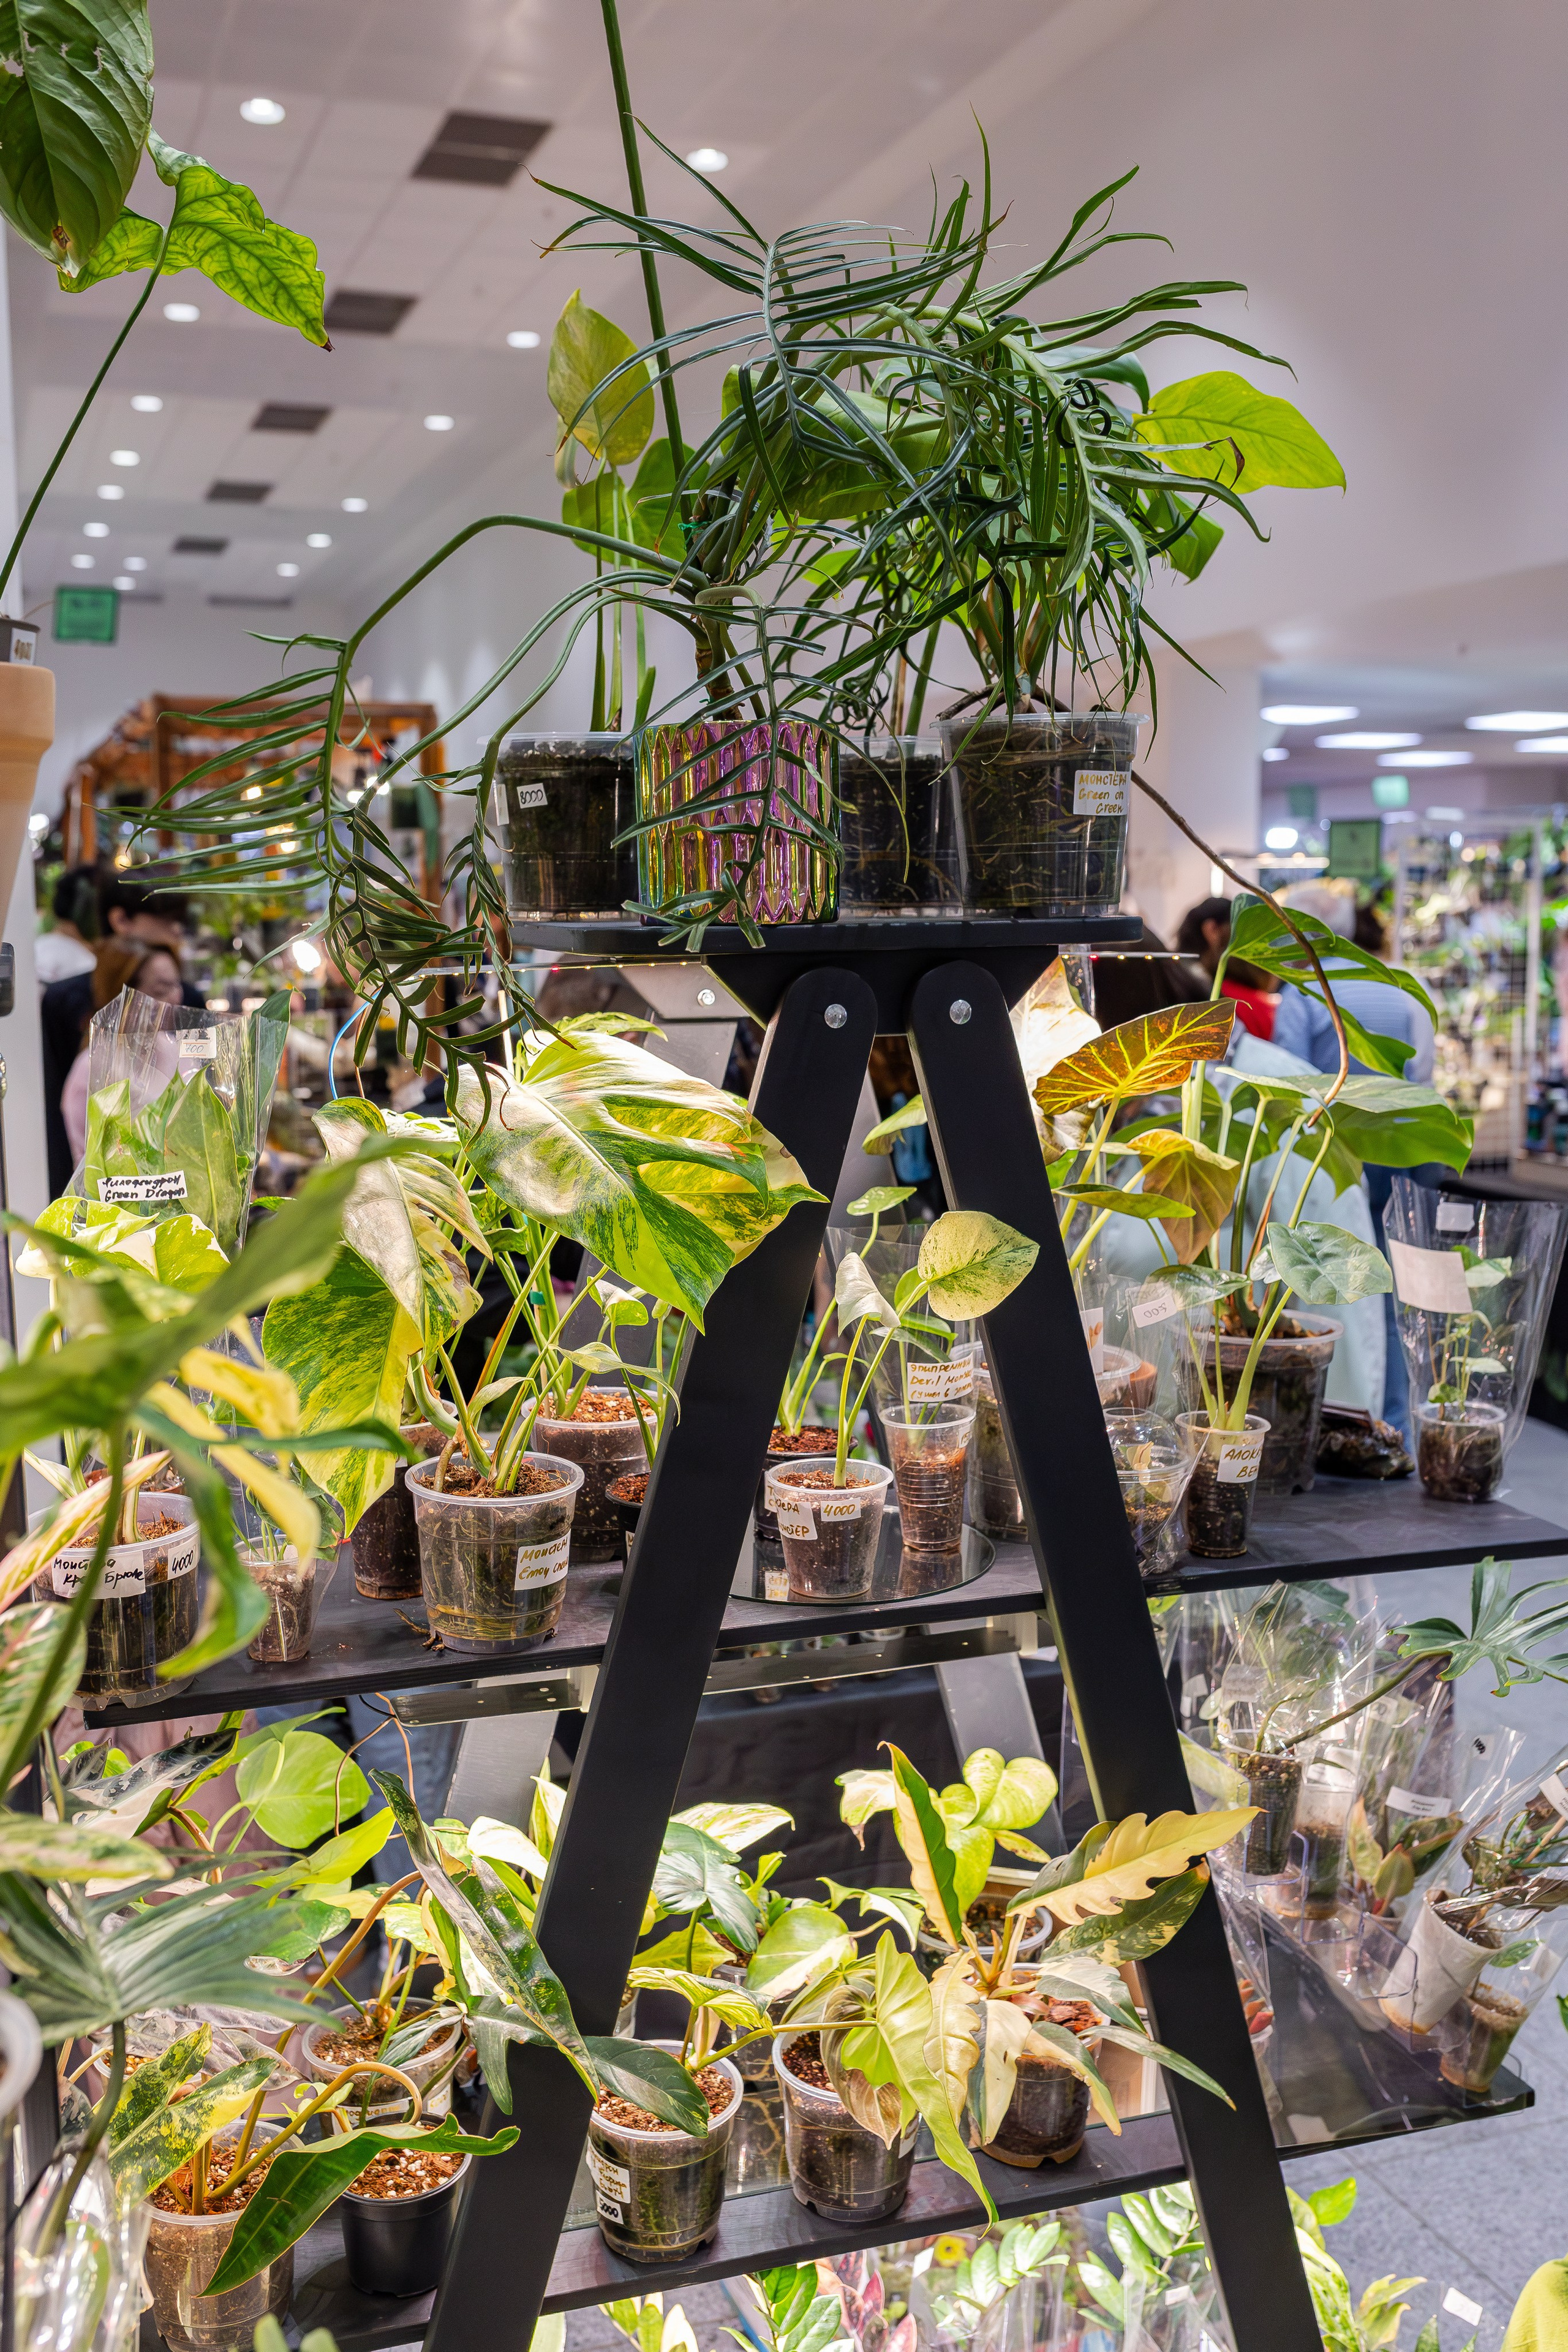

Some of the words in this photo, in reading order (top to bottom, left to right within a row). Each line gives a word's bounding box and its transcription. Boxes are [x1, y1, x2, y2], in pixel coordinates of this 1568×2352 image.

[519, 788, 544, 805] 8000
[1078, 788, 1110, 800] Green
[1115, 791, 1124, 800] on
[1095, 802, 1124, 814] Green
[104, 1189, 139, 1202] Green
[145, 1187, 185, 1199] Dragon
[823, 1504, 856, 1517] 4000
[54, 1556, 116, 1571] Монста
[172, 1550, 194, 1574] 4000
